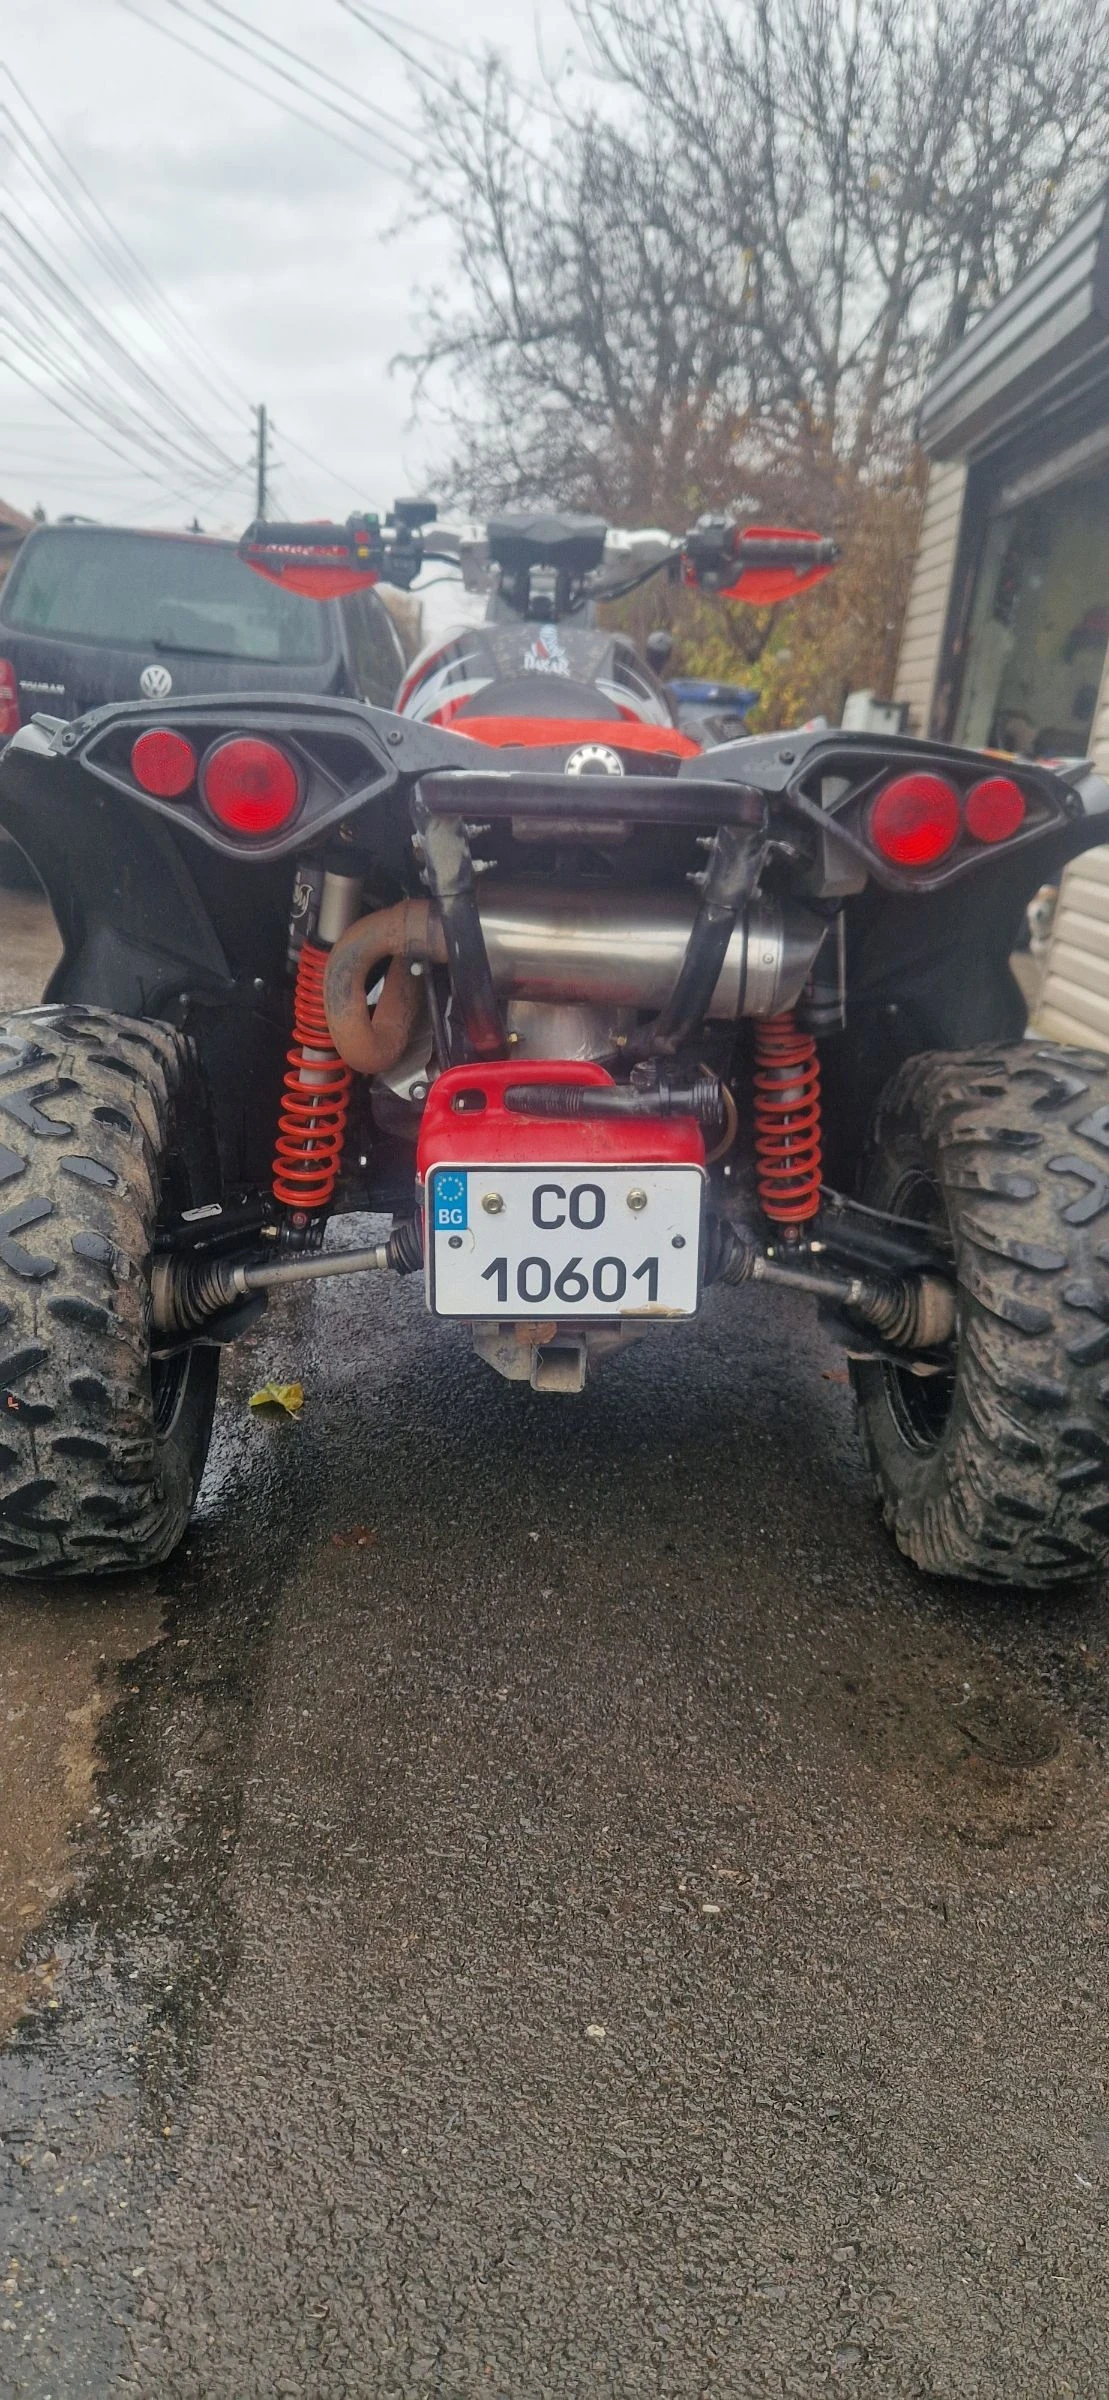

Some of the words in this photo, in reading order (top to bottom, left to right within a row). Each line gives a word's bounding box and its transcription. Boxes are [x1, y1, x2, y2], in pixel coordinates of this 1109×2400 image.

[438, 1209, 463, 1225] BG
[532, 1183, 606, 1230] CO
[480, 1256, 659, 1302] 10601
